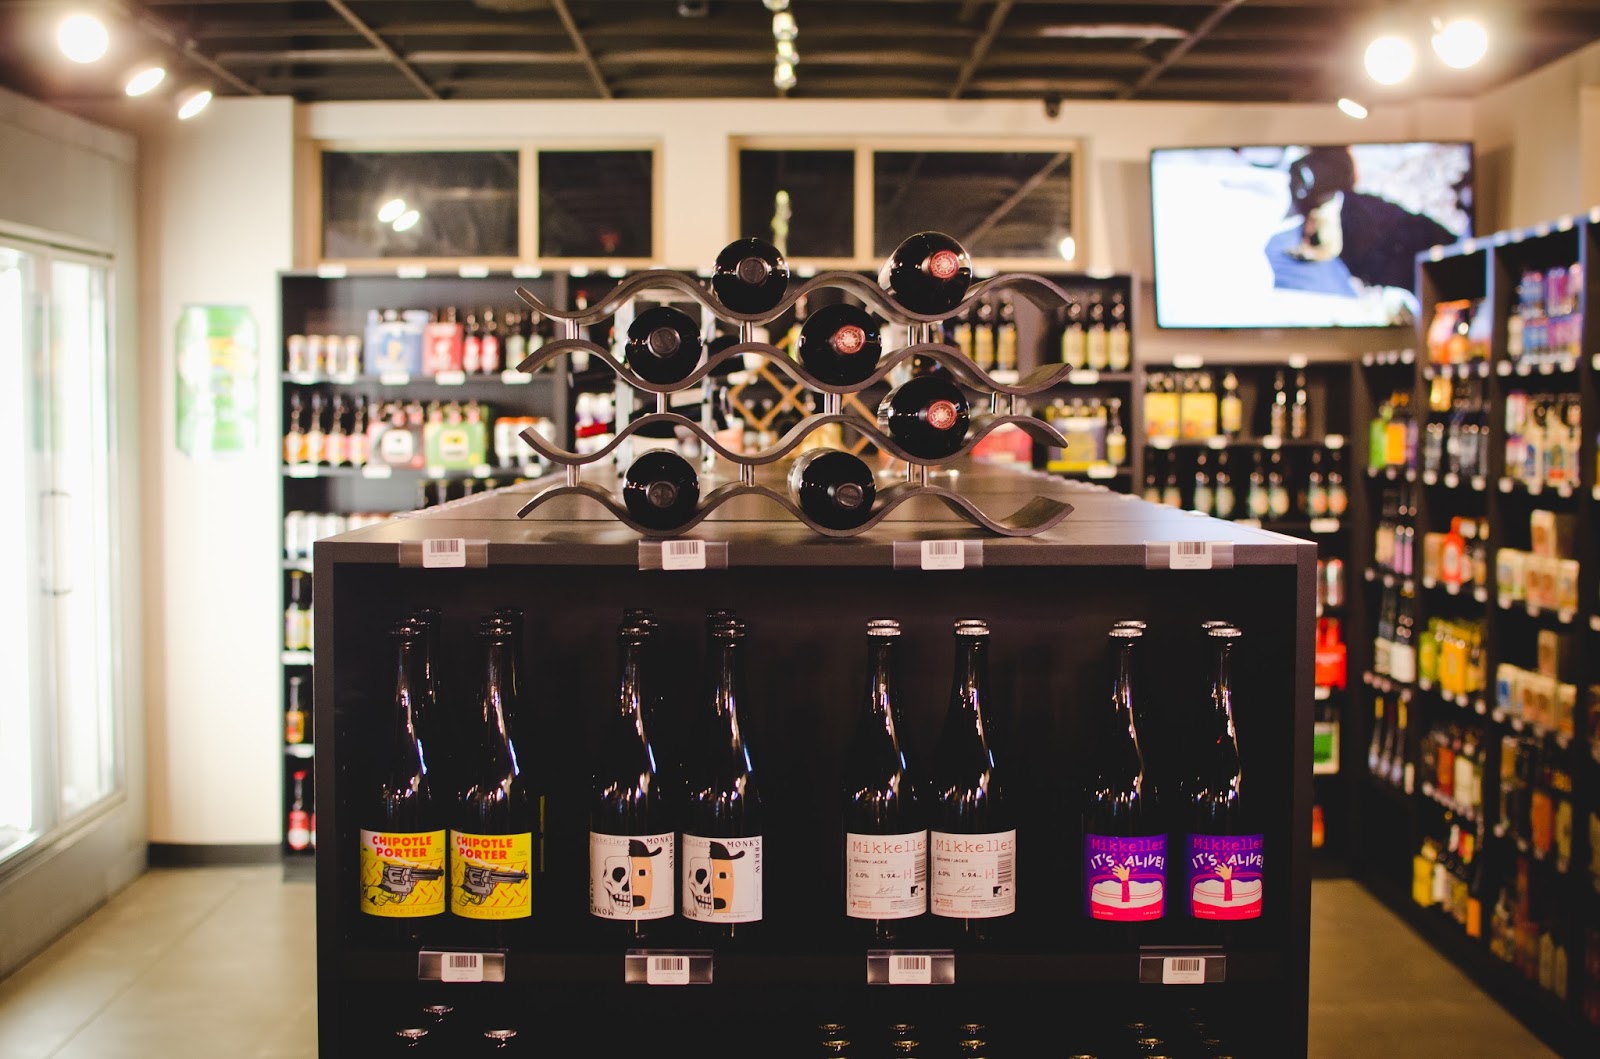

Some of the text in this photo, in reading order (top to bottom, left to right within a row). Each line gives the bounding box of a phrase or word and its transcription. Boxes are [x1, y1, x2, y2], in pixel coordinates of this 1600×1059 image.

[372, 835, 432, 847] CHIPOTLE
[456, 836, 513, 848] CHIPOTLE
[727, 838, 760, 848] MONK'S
[853, 839, 927, 854] Mikkeller
[936, 839, 1013, 853] Mikkeller
[1091, 838, 1165, 852] Mikkeller
[376, 847, 427, 858] PORTER
[459, 848, 508, 860] PORTER
[1090, 853, 1165, 871] IT'S ALIVE!
[1192, 852, 1264, 869] IT'S ALIVE!
